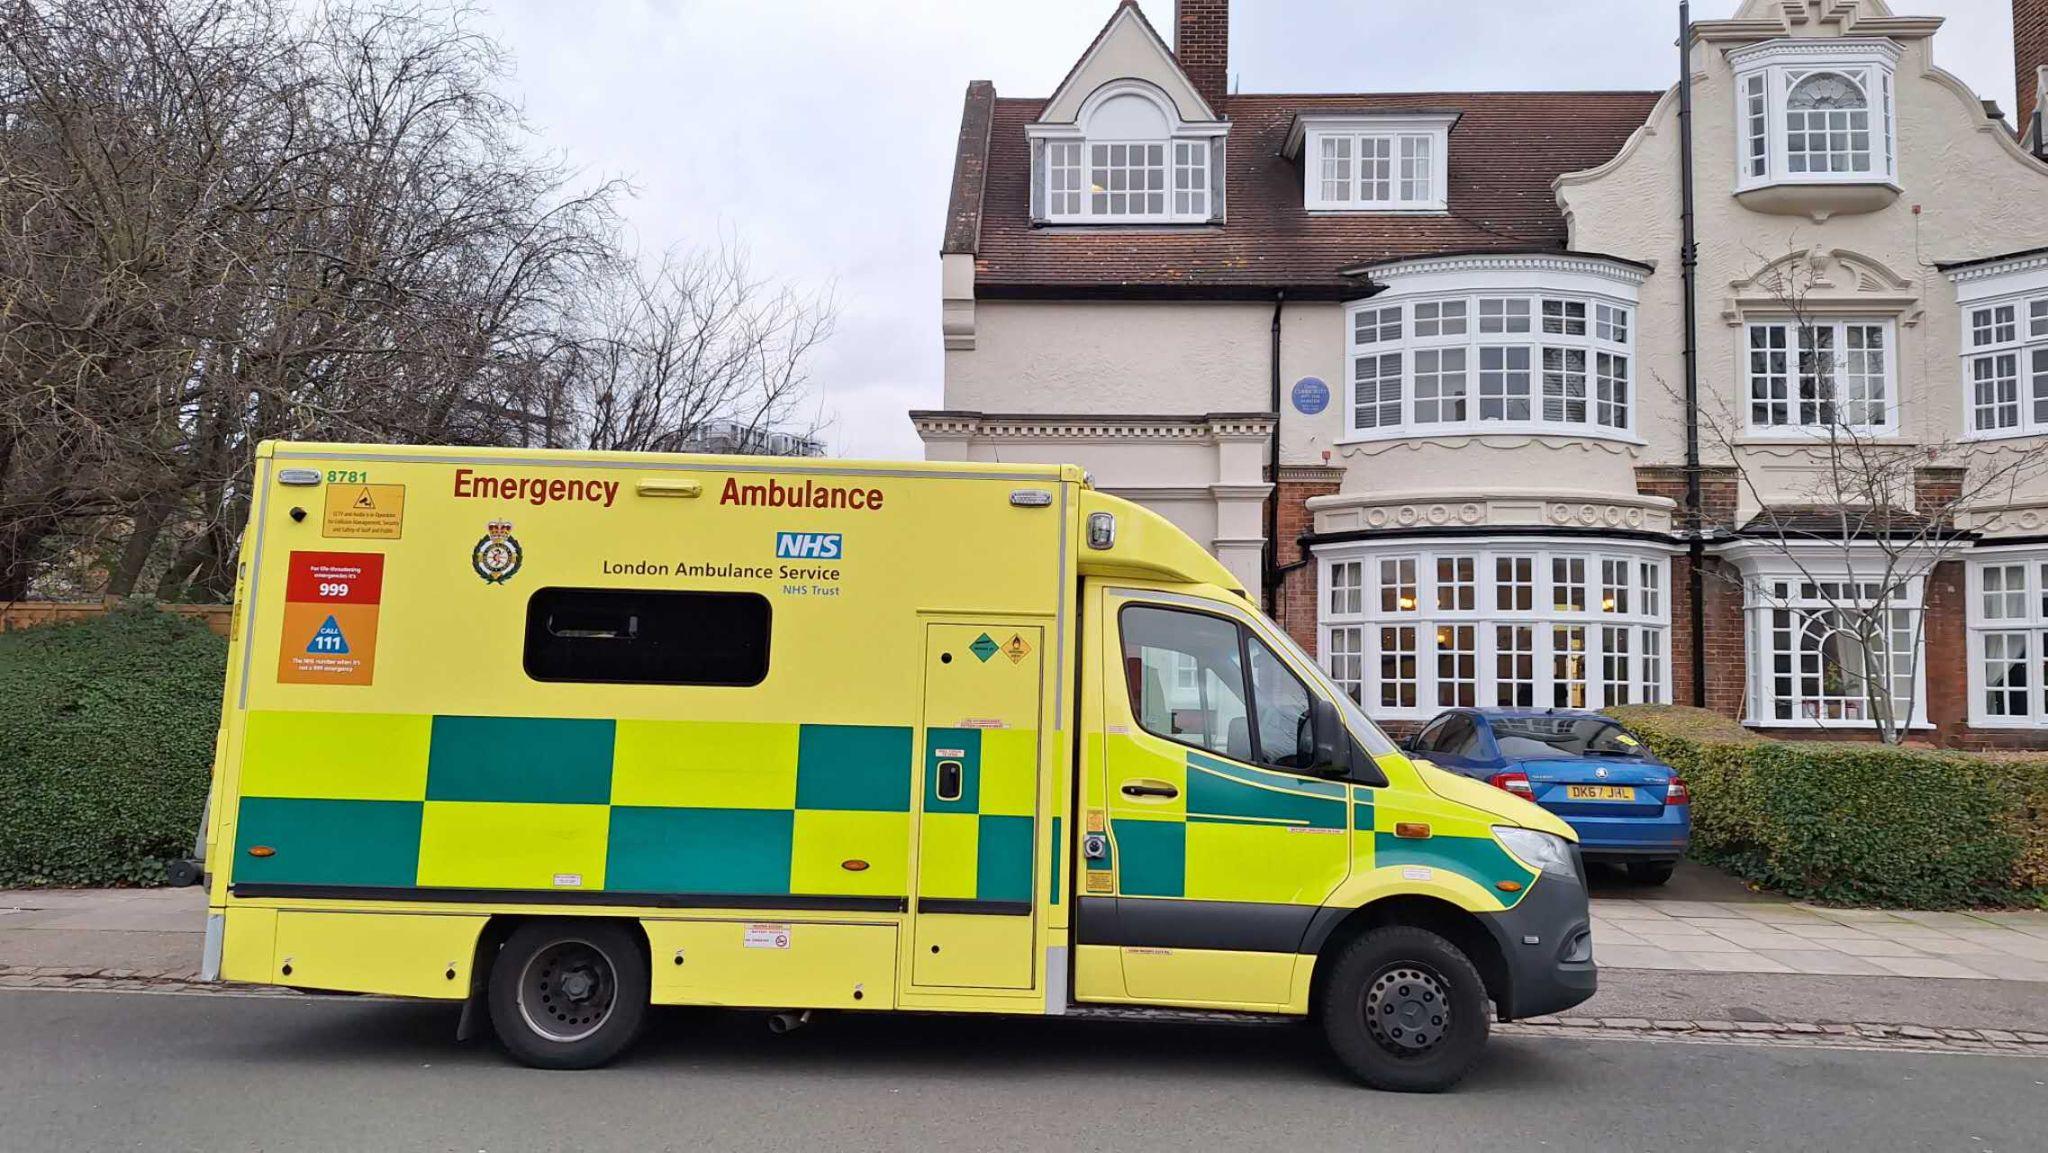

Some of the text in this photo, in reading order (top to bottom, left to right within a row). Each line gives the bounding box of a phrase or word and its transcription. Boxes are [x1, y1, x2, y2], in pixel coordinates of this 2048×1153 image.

[327, 470, 367, 483] 8781
[454, 469, 884, 511] Emergency Ambulance
[777, 533, 841, 558] NHS
[603, 560, 840, 581] London Ambulance Service
[319, 583, 349, 596] 999
[783, 585, 840, 597] NHS Trust
[320, 627, 339, 635] CALL
[315, 636, 341, 650] 111
